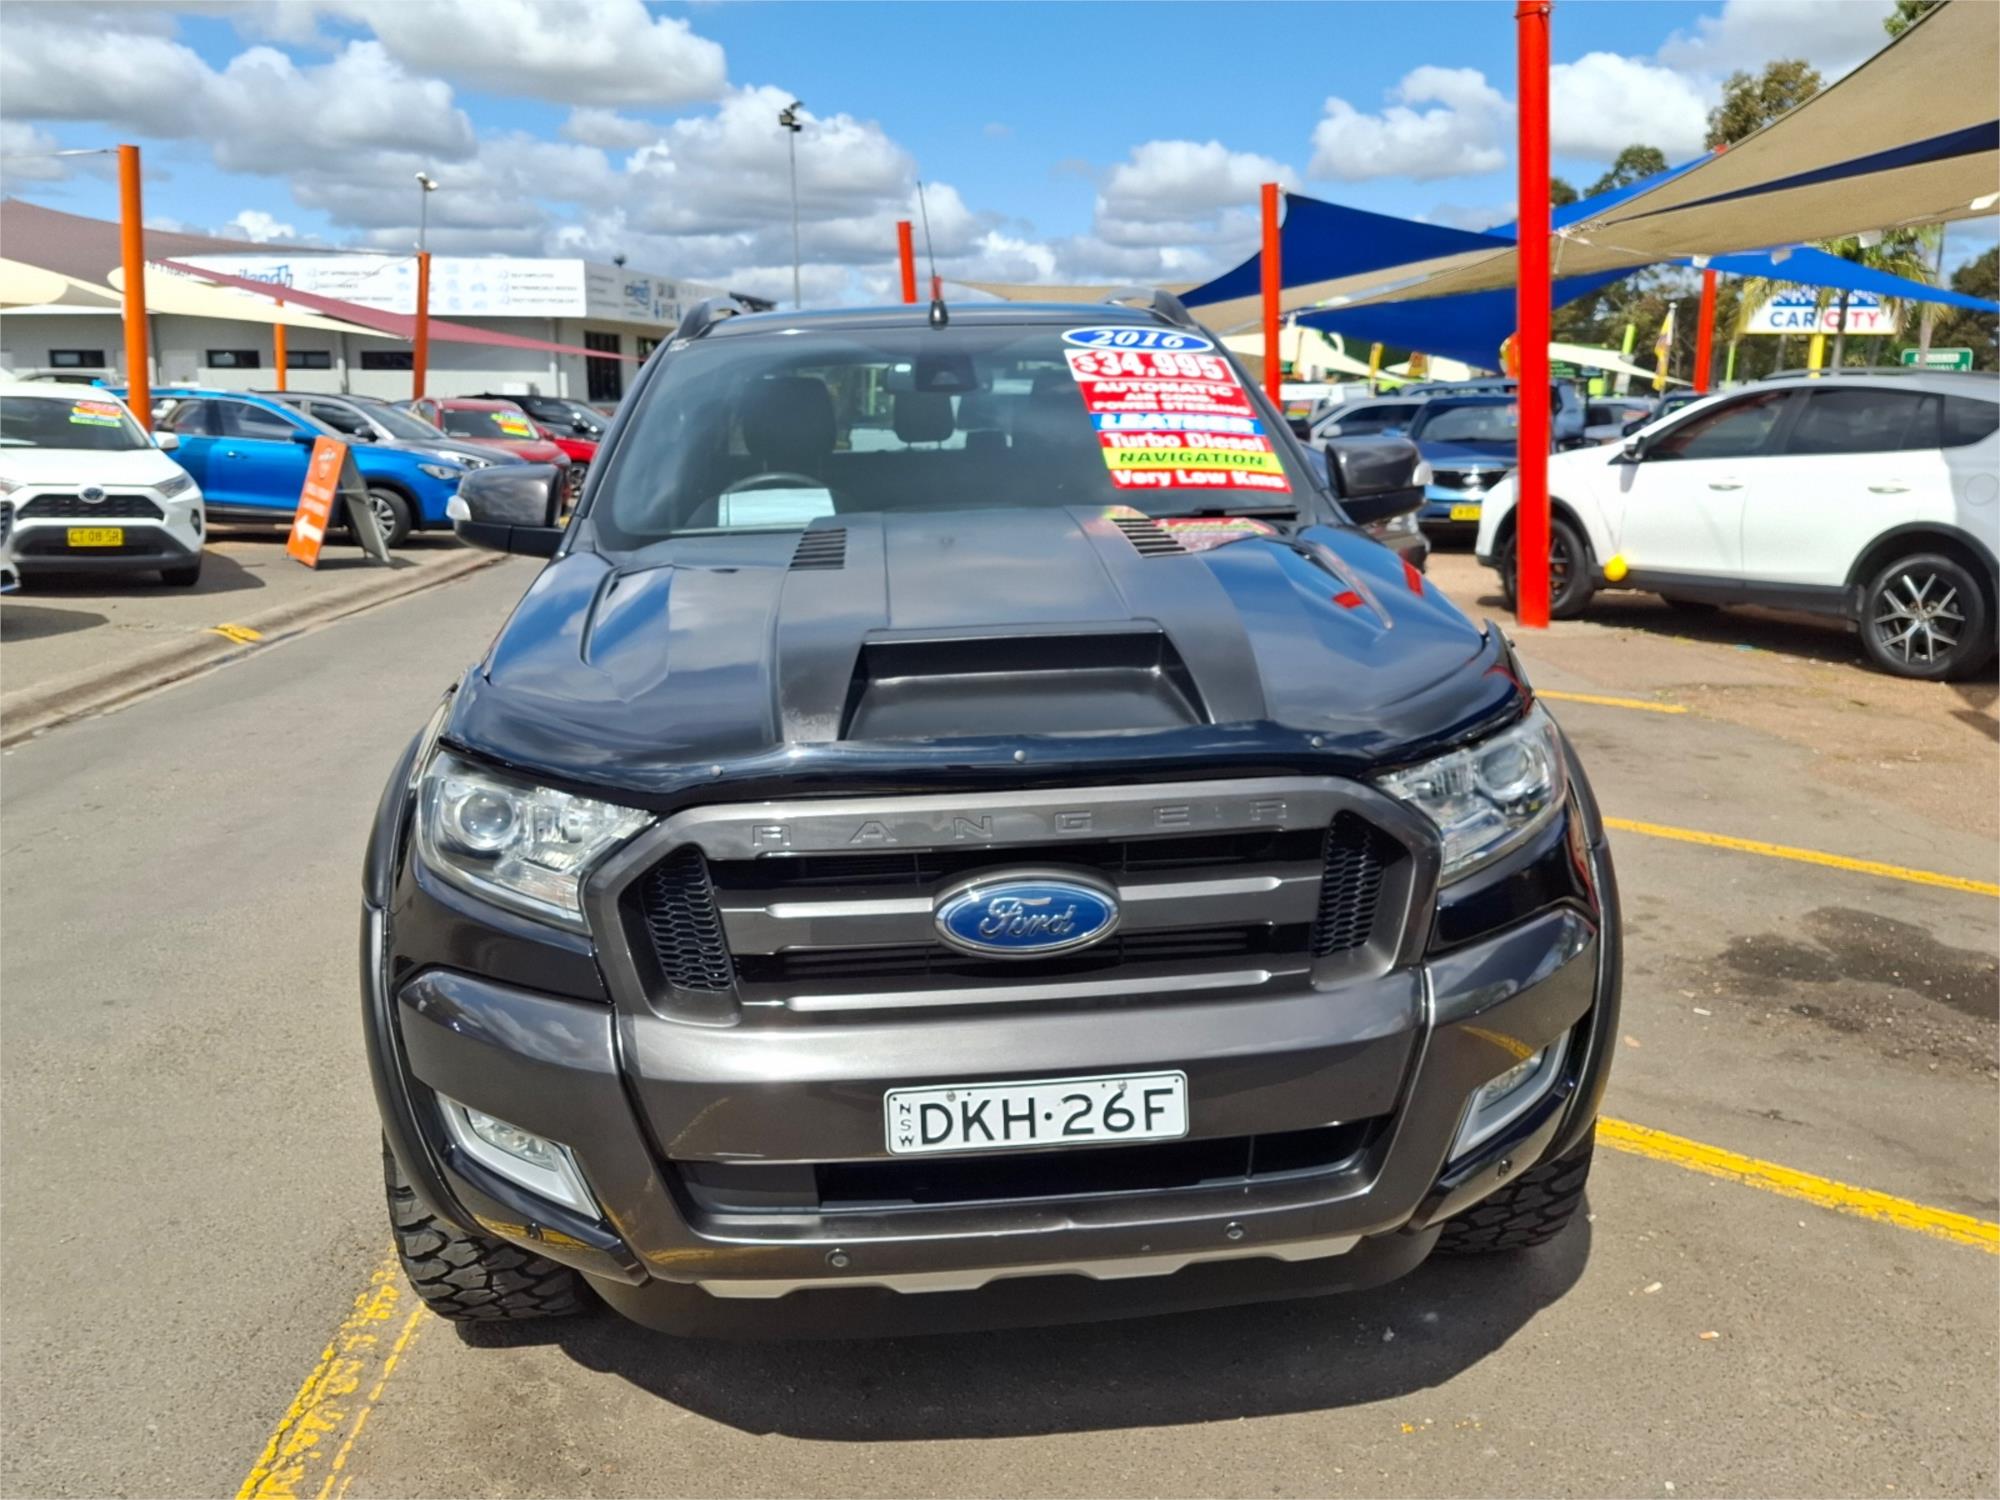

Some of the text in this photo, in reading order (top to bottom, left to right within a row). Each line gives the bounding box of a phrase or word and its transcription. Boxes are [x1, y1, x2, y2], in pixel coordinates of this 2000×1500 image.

[1770, 311, 1879, 328] CAR CTY
[1090, 330, 1185, 348] 2016
[1074, 350, 1224, 380] $34,995
[1093, 381, 1234, 397] AUTOMATIC
[1101, 413, 1255, 434] LEATHER
[1104, 432, 1267, 453] Turbo Diesel
[1119, 452, 1263, 466] NAVIGATION
[1112, 469, 1286, 489] Very Low Kms
[752, 799, 1288, 847] RANGER
[979, 896, 1078, 938] Ford
